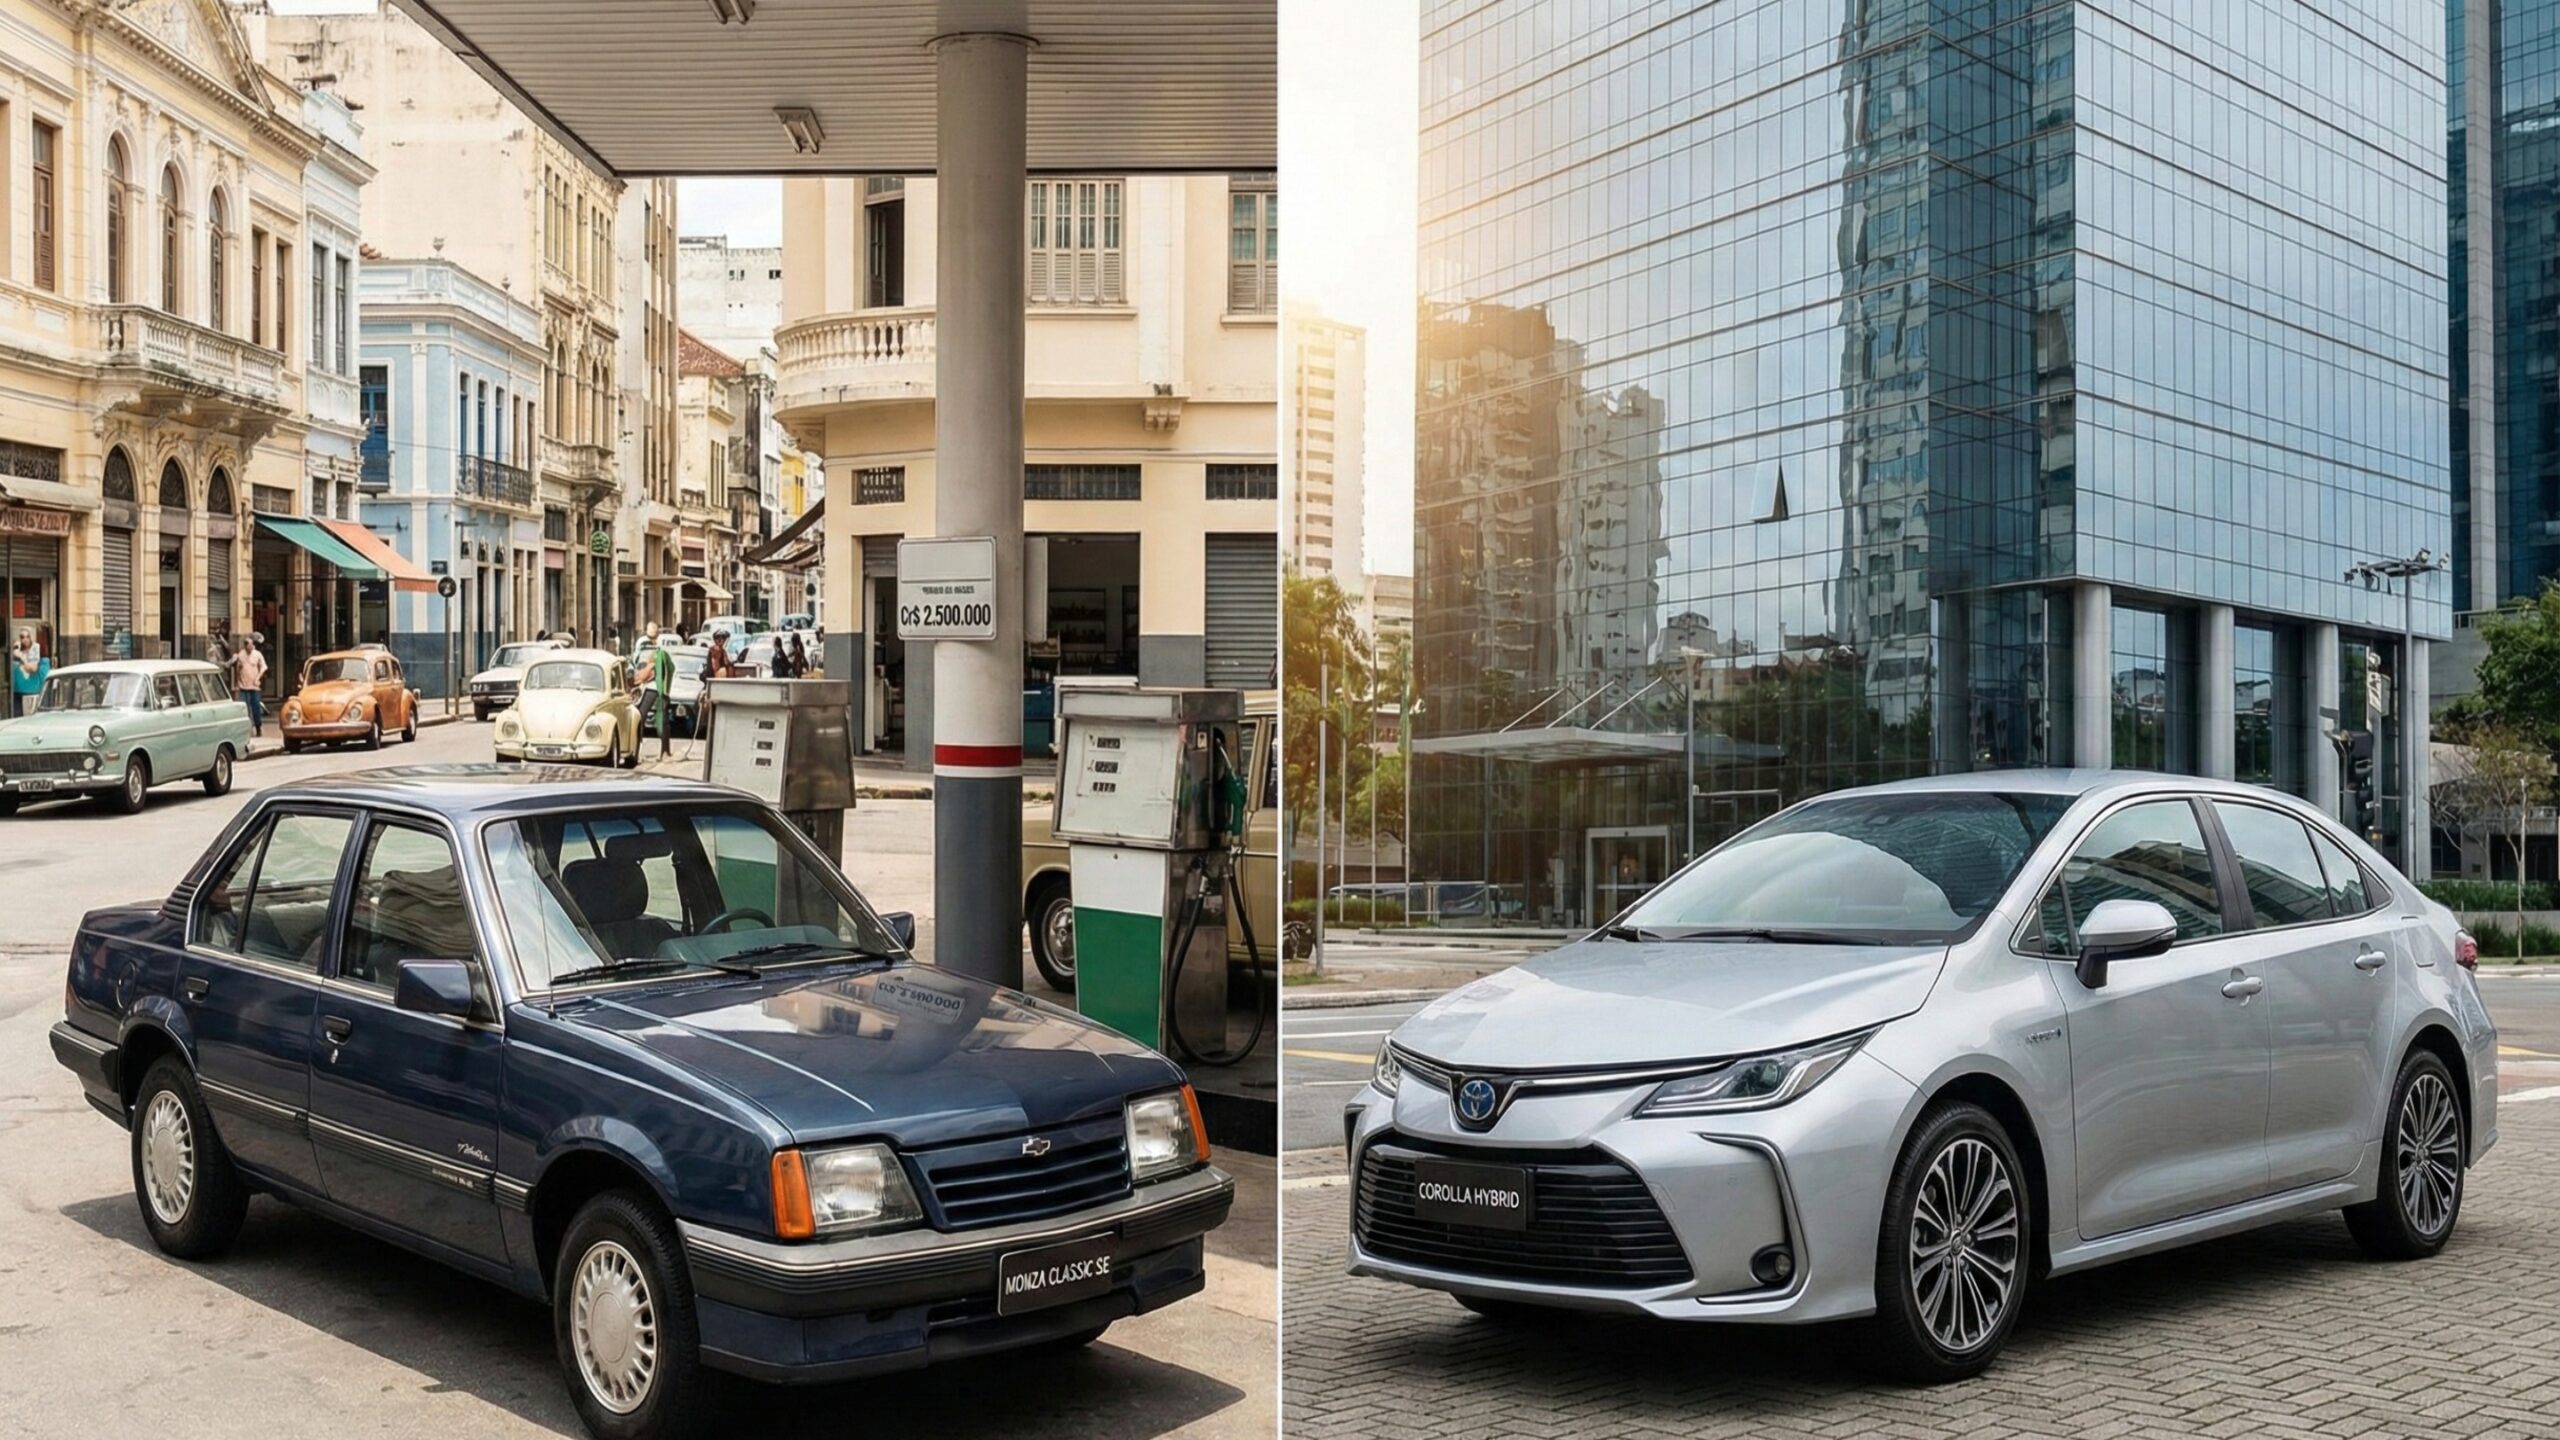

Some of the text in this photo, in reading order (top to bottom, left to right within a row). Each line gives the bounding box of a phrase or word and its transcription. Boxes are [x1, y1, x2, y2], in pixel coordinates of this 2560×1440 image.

[901, 604, 991, 627] Cr$ 2.500.000
[1418, 1182, 1520, 1209] COROLLA HYBRID
[1005, 1256, 1111, 1295] MONZA CLASSIC SE
